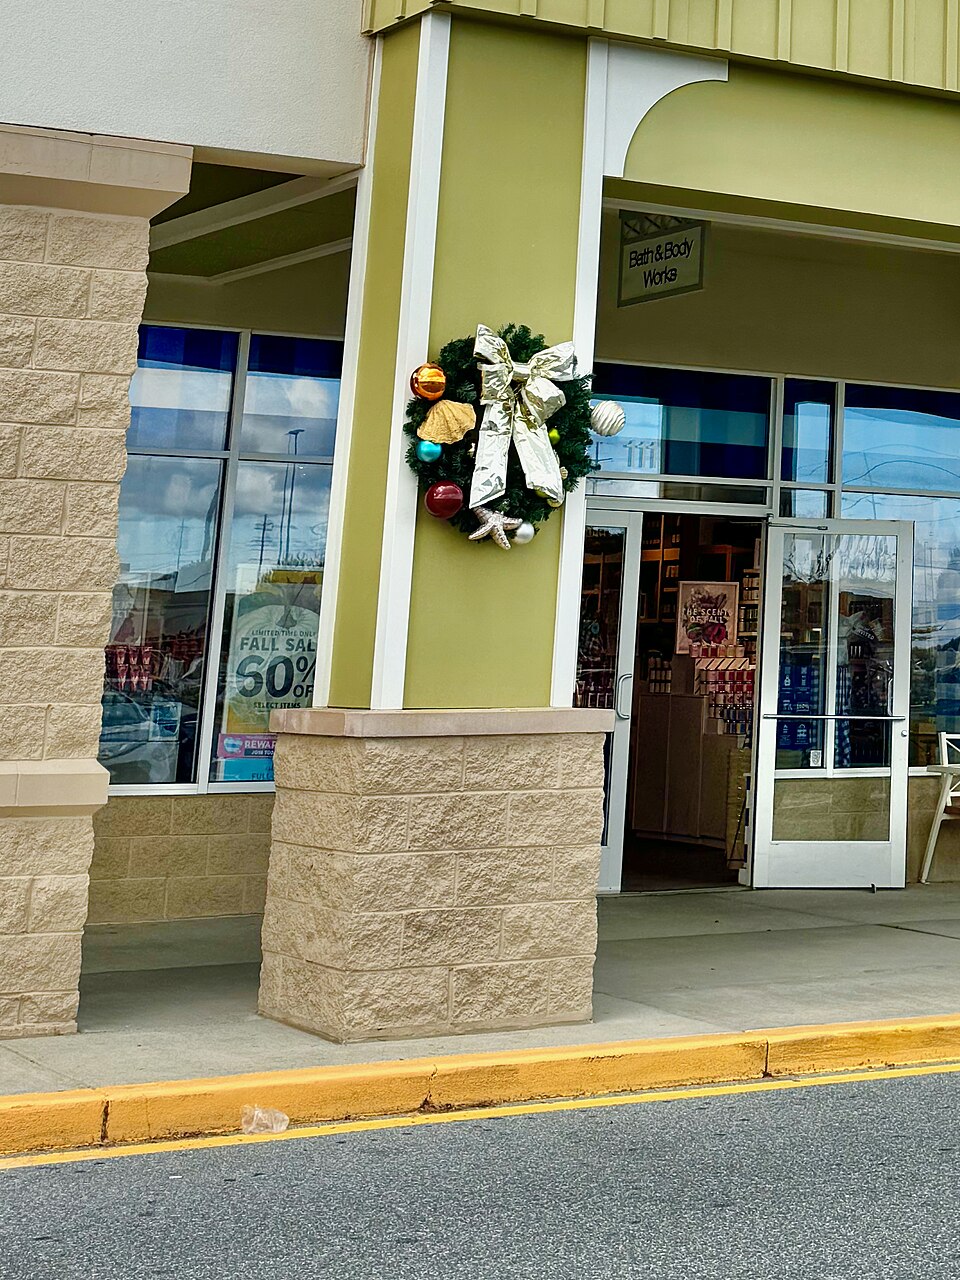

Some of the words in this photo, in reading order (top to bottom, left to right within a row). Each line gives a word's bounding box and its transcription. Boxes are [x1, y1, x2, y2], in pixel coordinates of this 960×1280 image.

[629, 247, 653, 268] Bath
[655, 244, 663, 262] &
[665, 237, 694, 260] Body
[643, 266, 677, 288] Works
[622, 440, 656, 469] 111
[701, 608, 728, 616] SCENT
[252, 629, 280, 637] LIMITED
[281, 629, 298, 637] TIME
[239, 637, 279, 651] FALL
[285, 637, 316, 652] SAL
[235, 654, 317, 698] 60%
[292, 685, 315, 698] OF
[253, 701, 278, 709] SELECT
